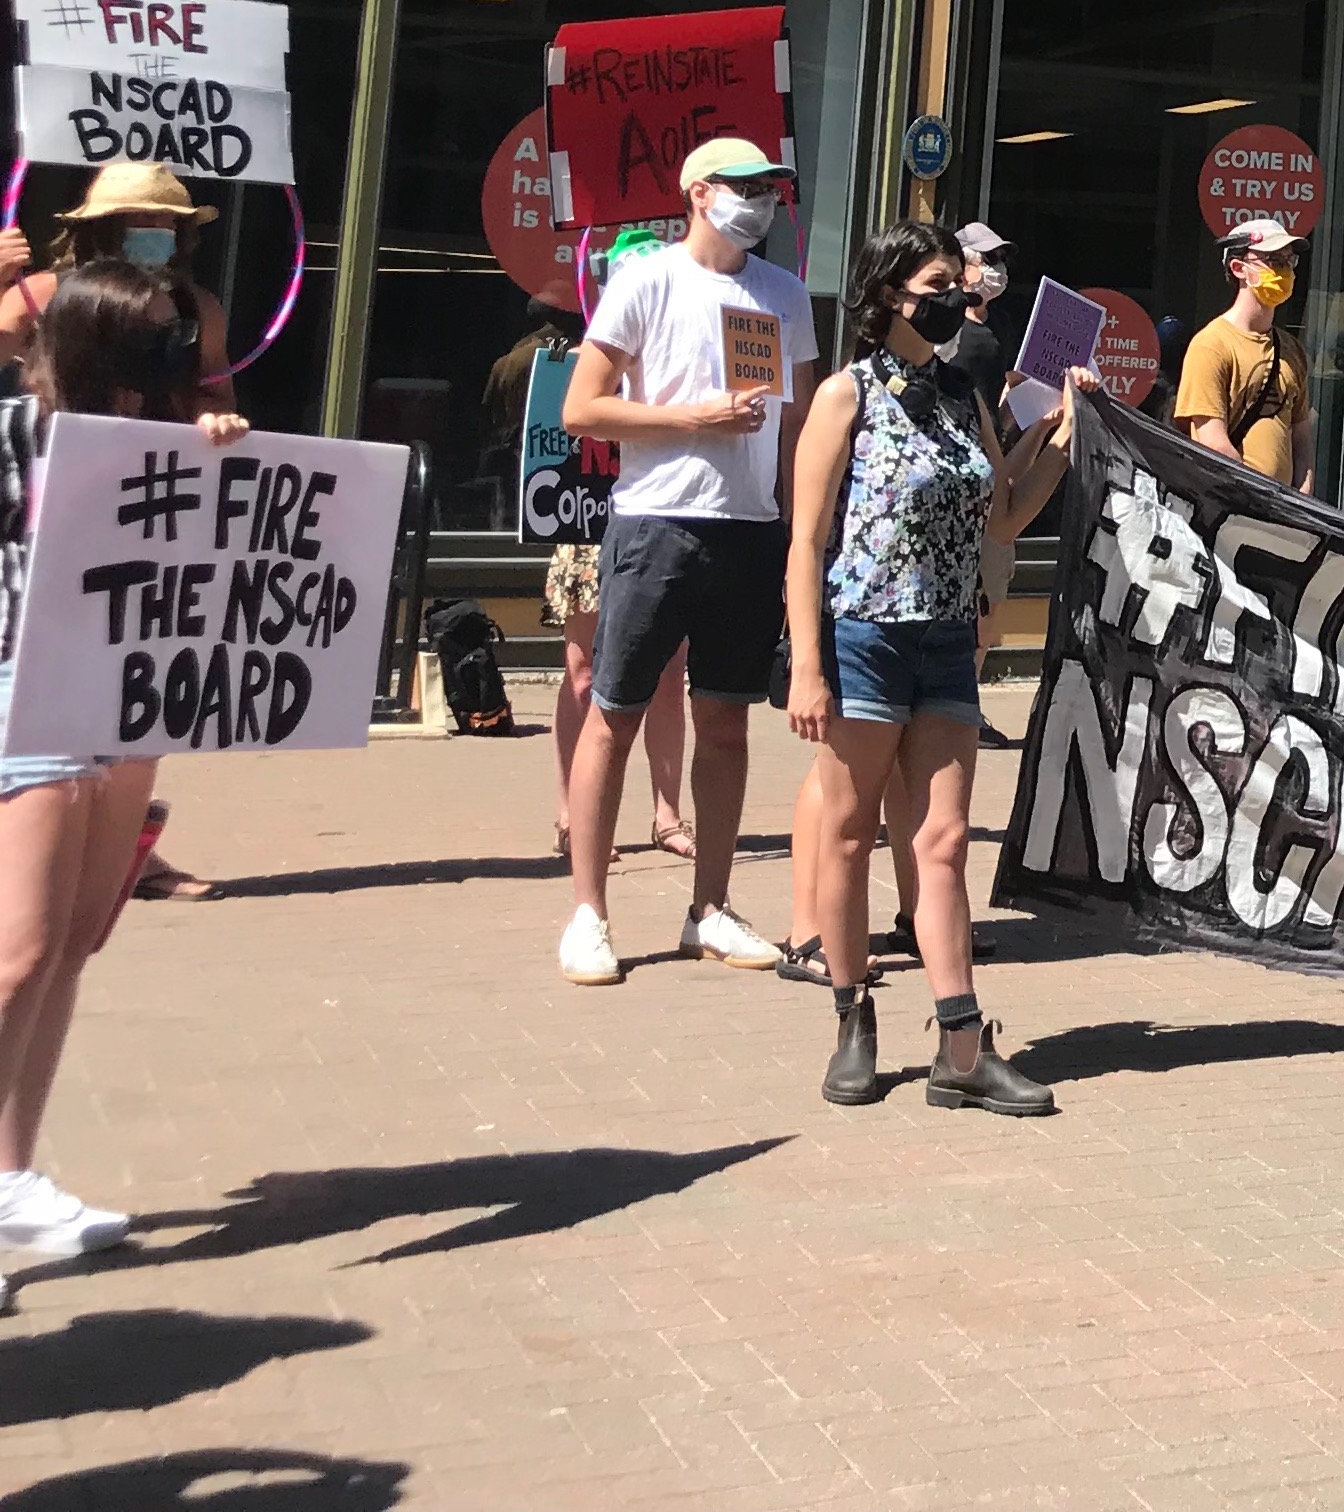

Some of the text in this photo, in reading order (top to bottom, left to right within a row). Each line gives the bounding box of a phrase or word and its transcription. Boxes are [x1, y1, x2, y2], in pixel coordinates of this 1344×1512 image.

[127, 52, 179, 77] THE
[90, 71, 233, 125] NSCAD
[68, 108, 253, 176] BOARD
[513, 137, 539, 162] A
[616, 105, 737, 199] AOIF
[1214, 148, 1313, 173] COME IN
[1210, 177, 1314, 202] & TRY US
[513, 202, 539, 228] is
[1221, 207, 1301, 230] TODAY
[728, 316, 775, 337] FIRE THE
[735, 340, 772, 358] NSCAD
[1042, 330, 1062, 348] FIRE
[1065, 342, 1080, 357] THE
[1105, 338, 1139, 351] TIME
[735, 363, 775, 382] BOARD
[528, 423, 568, 458] FREE
[82, 558, 357, 649] THE NSCAD
[119, 643, 312, 750] BOARD
